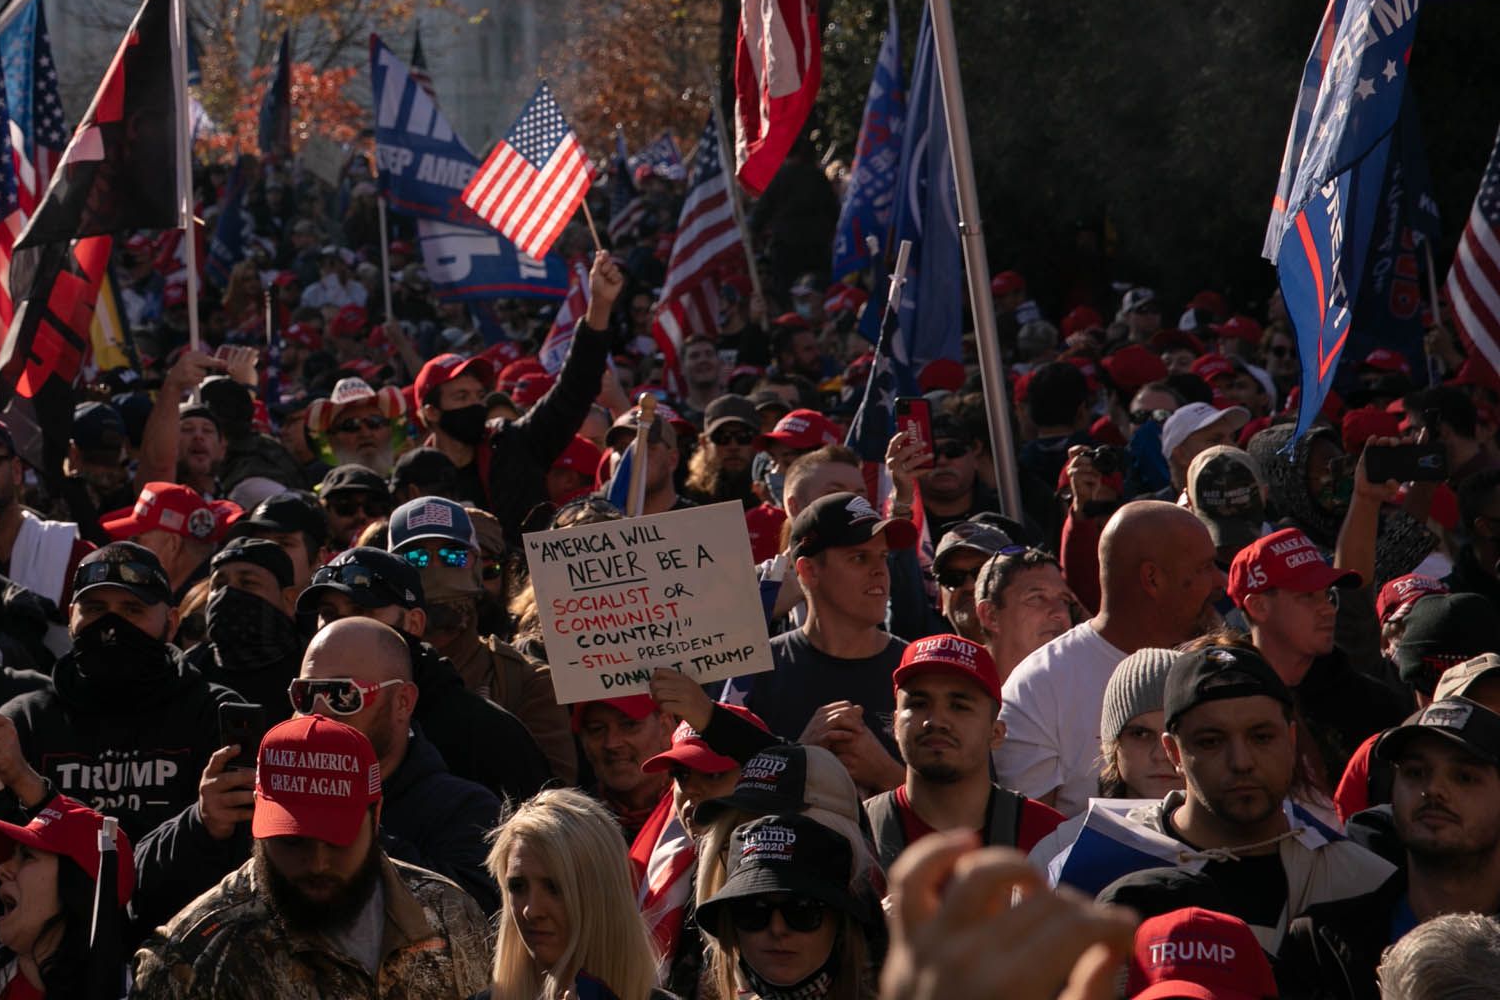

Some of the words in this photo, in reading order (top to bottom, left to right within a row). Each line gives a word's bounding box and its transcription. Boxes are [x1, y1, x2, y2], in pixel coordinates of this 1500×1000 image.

[620, 525, 666, 547] WILL
[567, 551, 647, 587] NEVER
[656, 549, 688, 571] BE
[697, 544, 714, 569] A
[1247, 564, 1269, 589] 45
[552, 586, 651, 617] SOCIALIST
[664, 582, 694, 600] OR
[554, 602, 679, 635] COMMUNIST
[637, 632, 726, 661] PRESIDENT
[916, 637, 978, 658] TRUMP
[600, 666, 652, 690] DONAL
[690, 645, 756, 672] TRUMP
[56, 758, 179, 792] TRUMP
[264, 747, 297, 768] MAKE
[298, 751, 361, 775] AMERICA
[270, 773, 308, 794] GREAT
[308, 777, 352, 798] AGAIN
[741, 829, 797, 847] Trump
[1148, 940, 1237, 965] TRUMP
